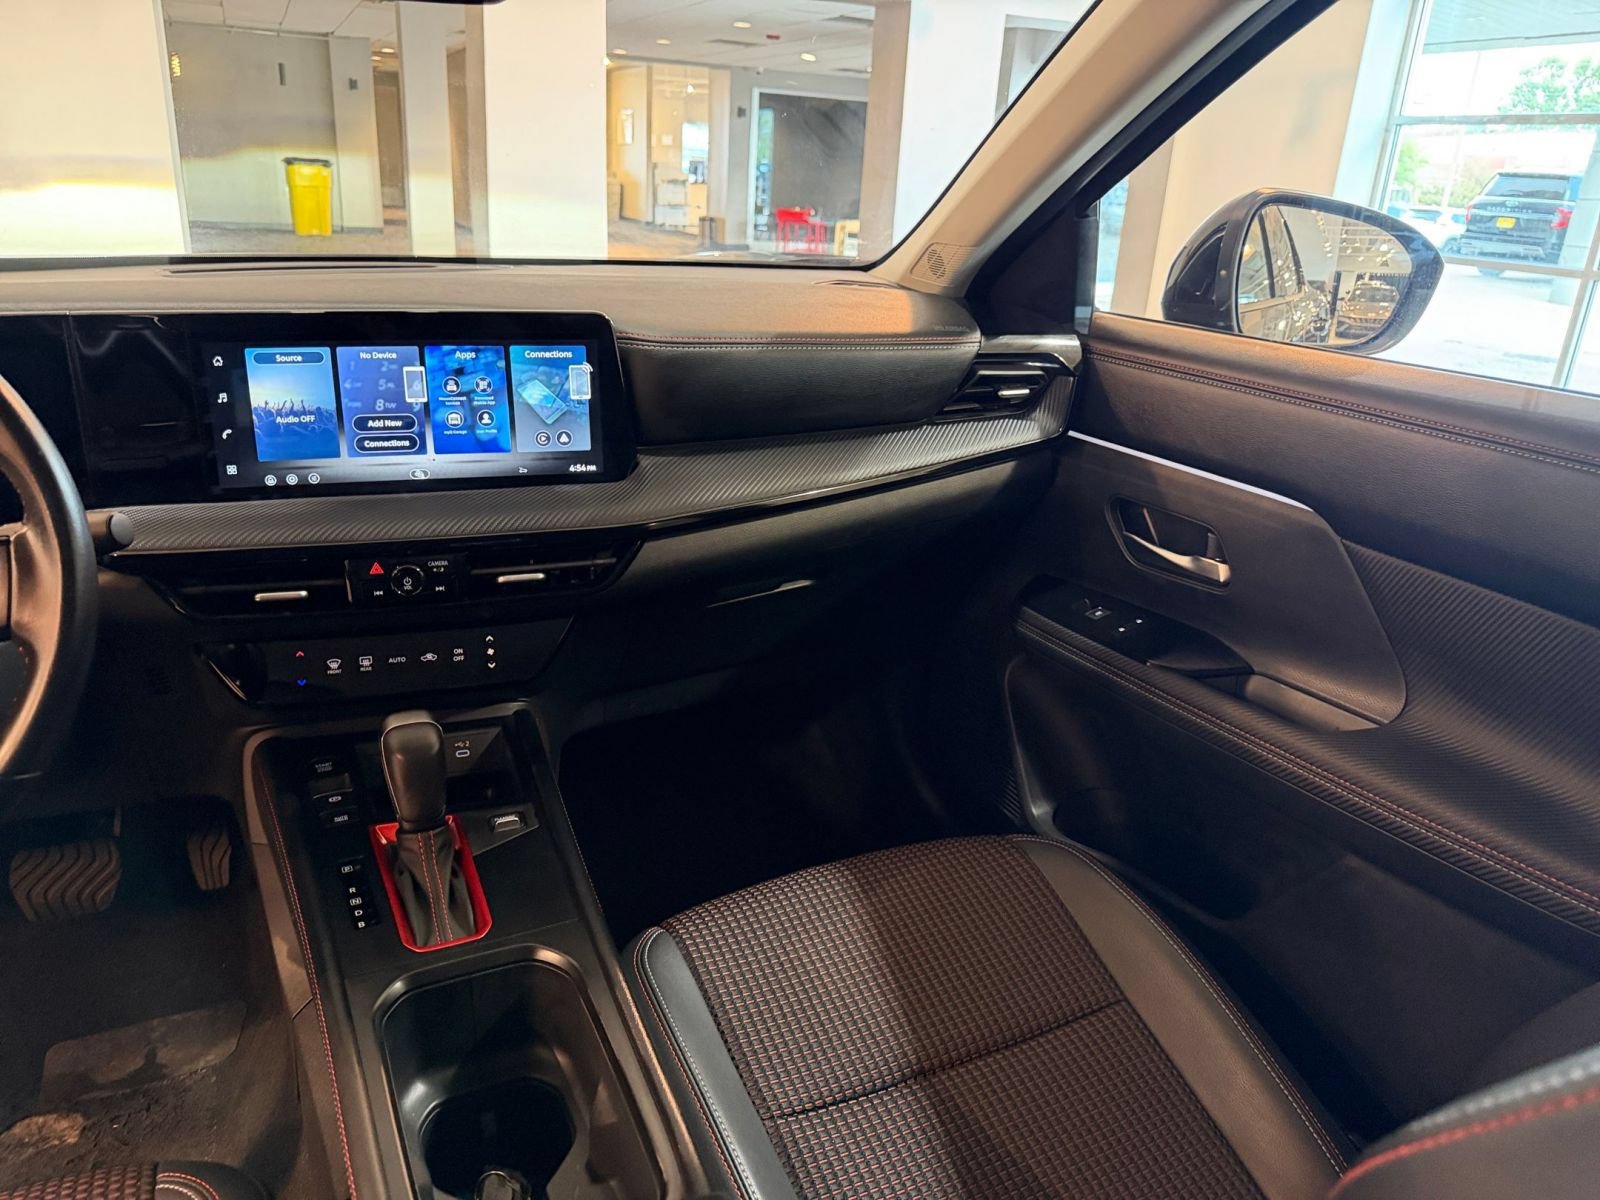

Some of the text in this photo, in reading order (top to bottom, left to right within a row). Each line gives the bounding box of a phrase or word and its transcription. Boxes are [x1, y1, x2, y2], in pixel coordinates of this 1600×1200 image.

[275, 354, 303, 362] Source
[360, 351, 397, 360] No Device
[455, 350, 476, 360] Apps
[524, 350, 573, 359] Connections
[375, 398, 385, 411] 8
[276, 415, 316, 424] Audio OFF
[367, 418, 402, 428] Add New
[364, 439, 410, 448] Connections
[569, 464, 597, 472] 4:54 PM
[388, 656, 406, 664] AUTO
[354, 909, 363, 917] D
[357, 921, 366, 929] B
